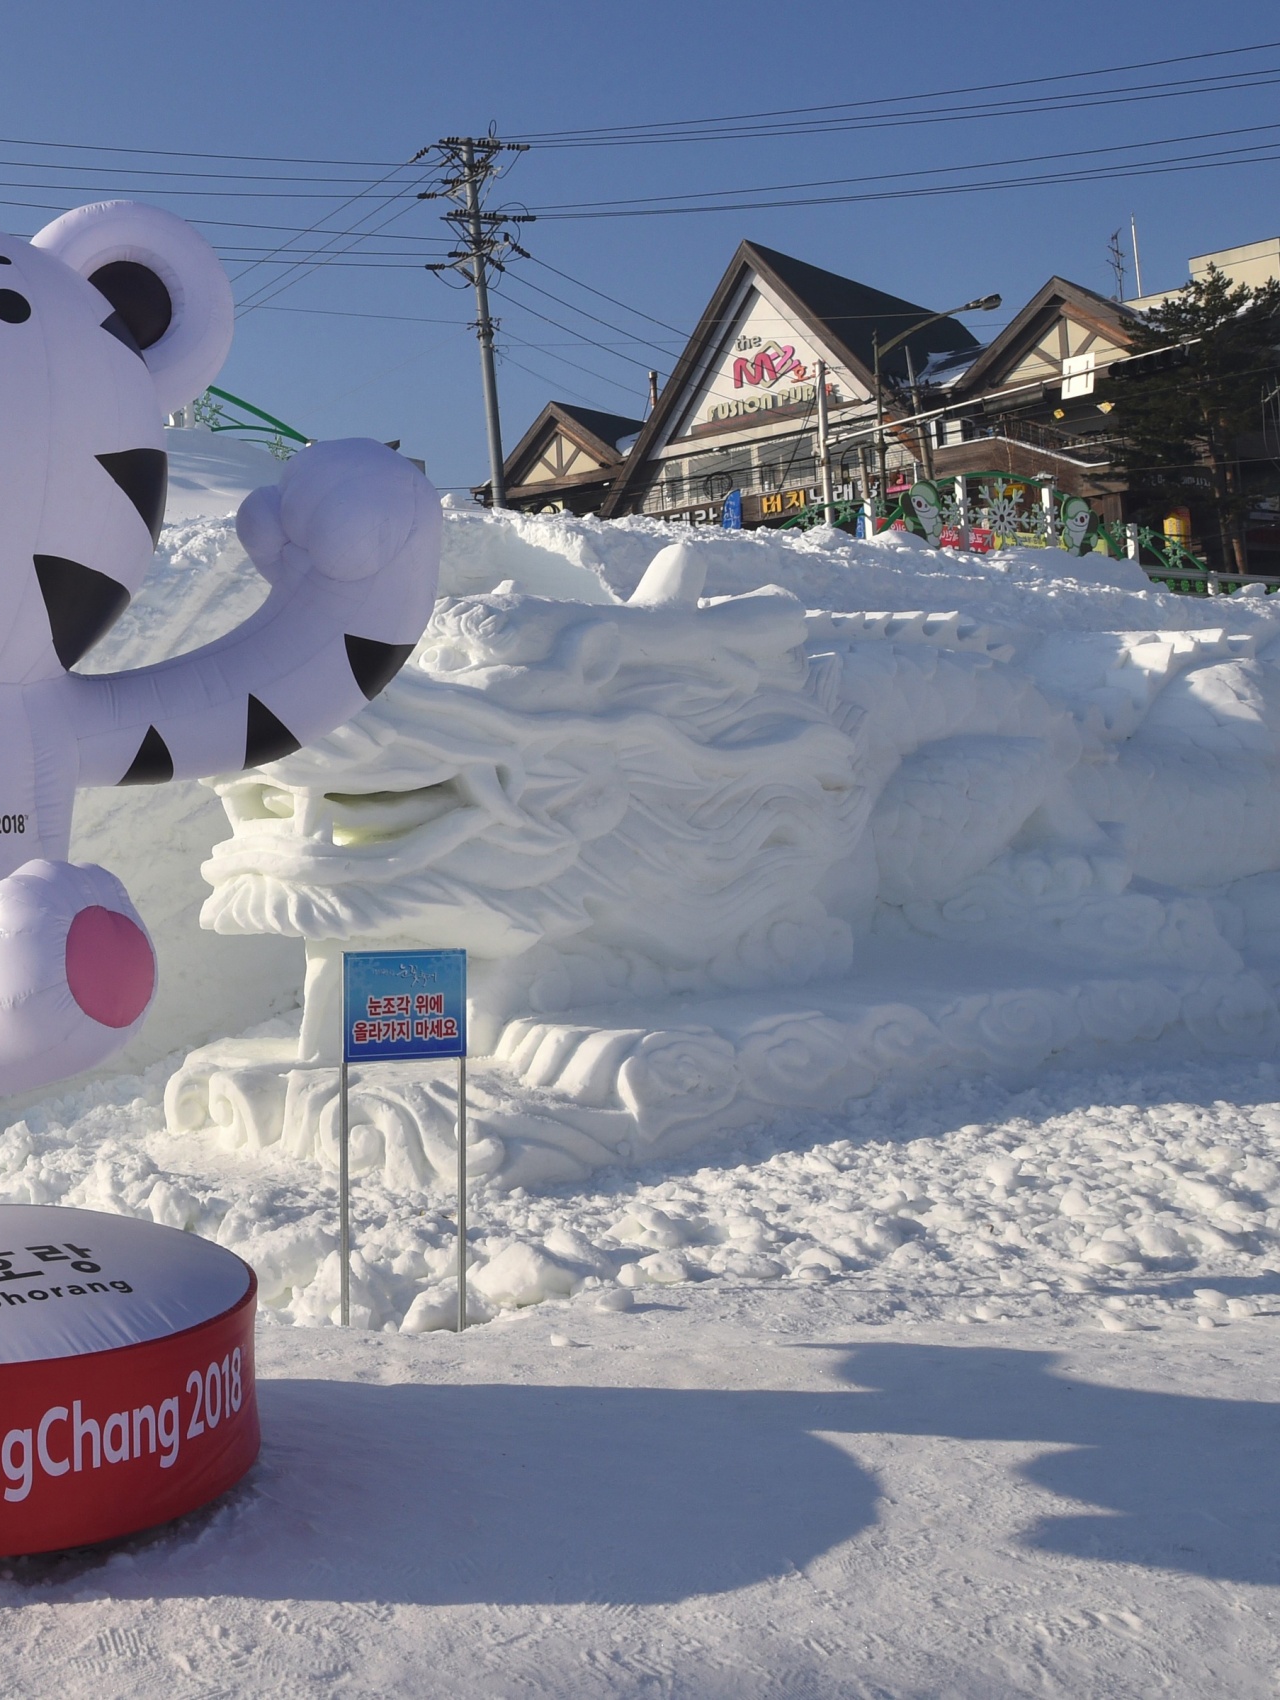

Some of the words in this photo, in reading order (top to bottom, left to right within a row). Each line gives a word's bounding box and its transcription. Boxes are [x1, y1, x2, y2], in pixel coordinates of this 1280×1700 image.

[735, 335, 762, 352] the
[777, 384, 816, 407] PUB
[367, 994, 411, 1017] 눈조각
[415, 993, 443, 1015] 위에
[353, 1020, 410, 1042] 올라가지
[415, 1018, 457, 1040] 마세요
[186, 1346, 243, 1440] 2018
